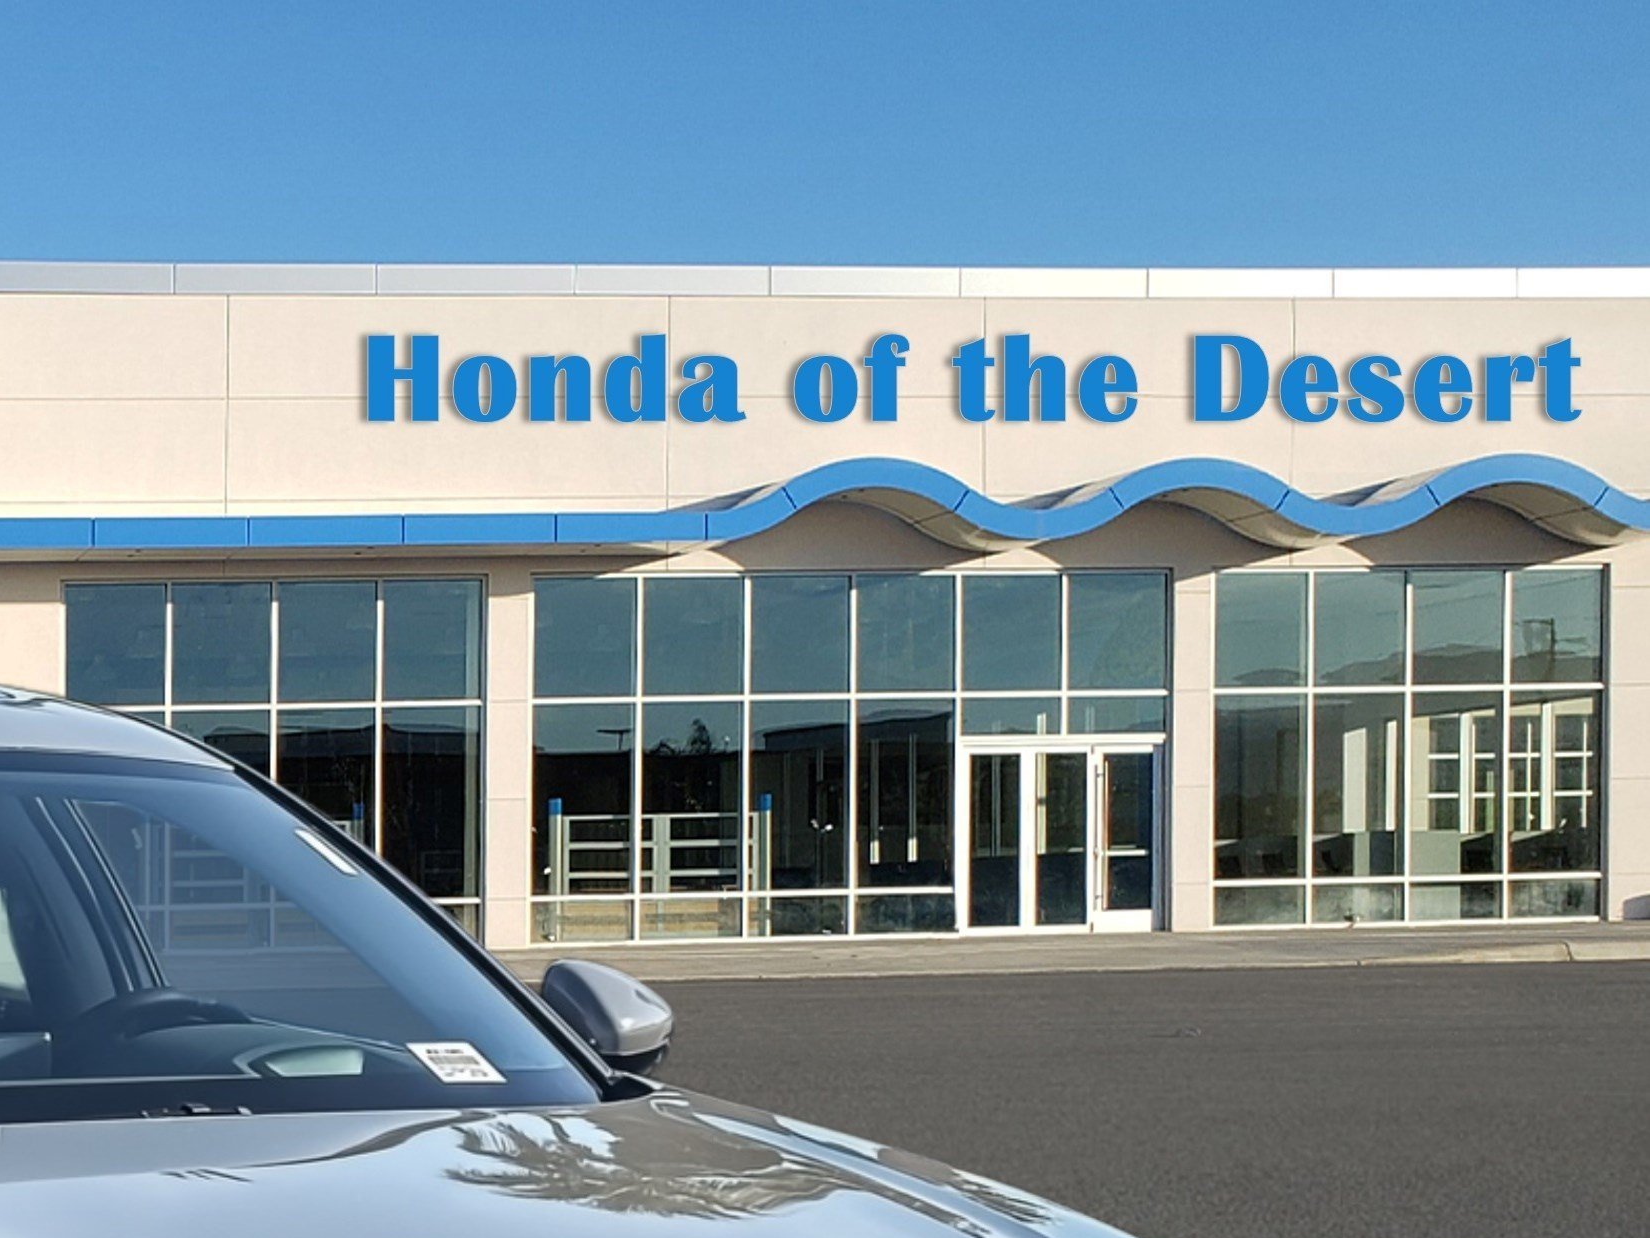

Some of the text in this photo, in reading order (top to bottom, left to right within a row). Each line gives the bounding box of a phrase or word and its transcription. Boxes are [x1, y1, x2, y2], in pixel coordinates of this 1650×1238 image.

[366, 333, 1583, 423] Honda of the Desert
